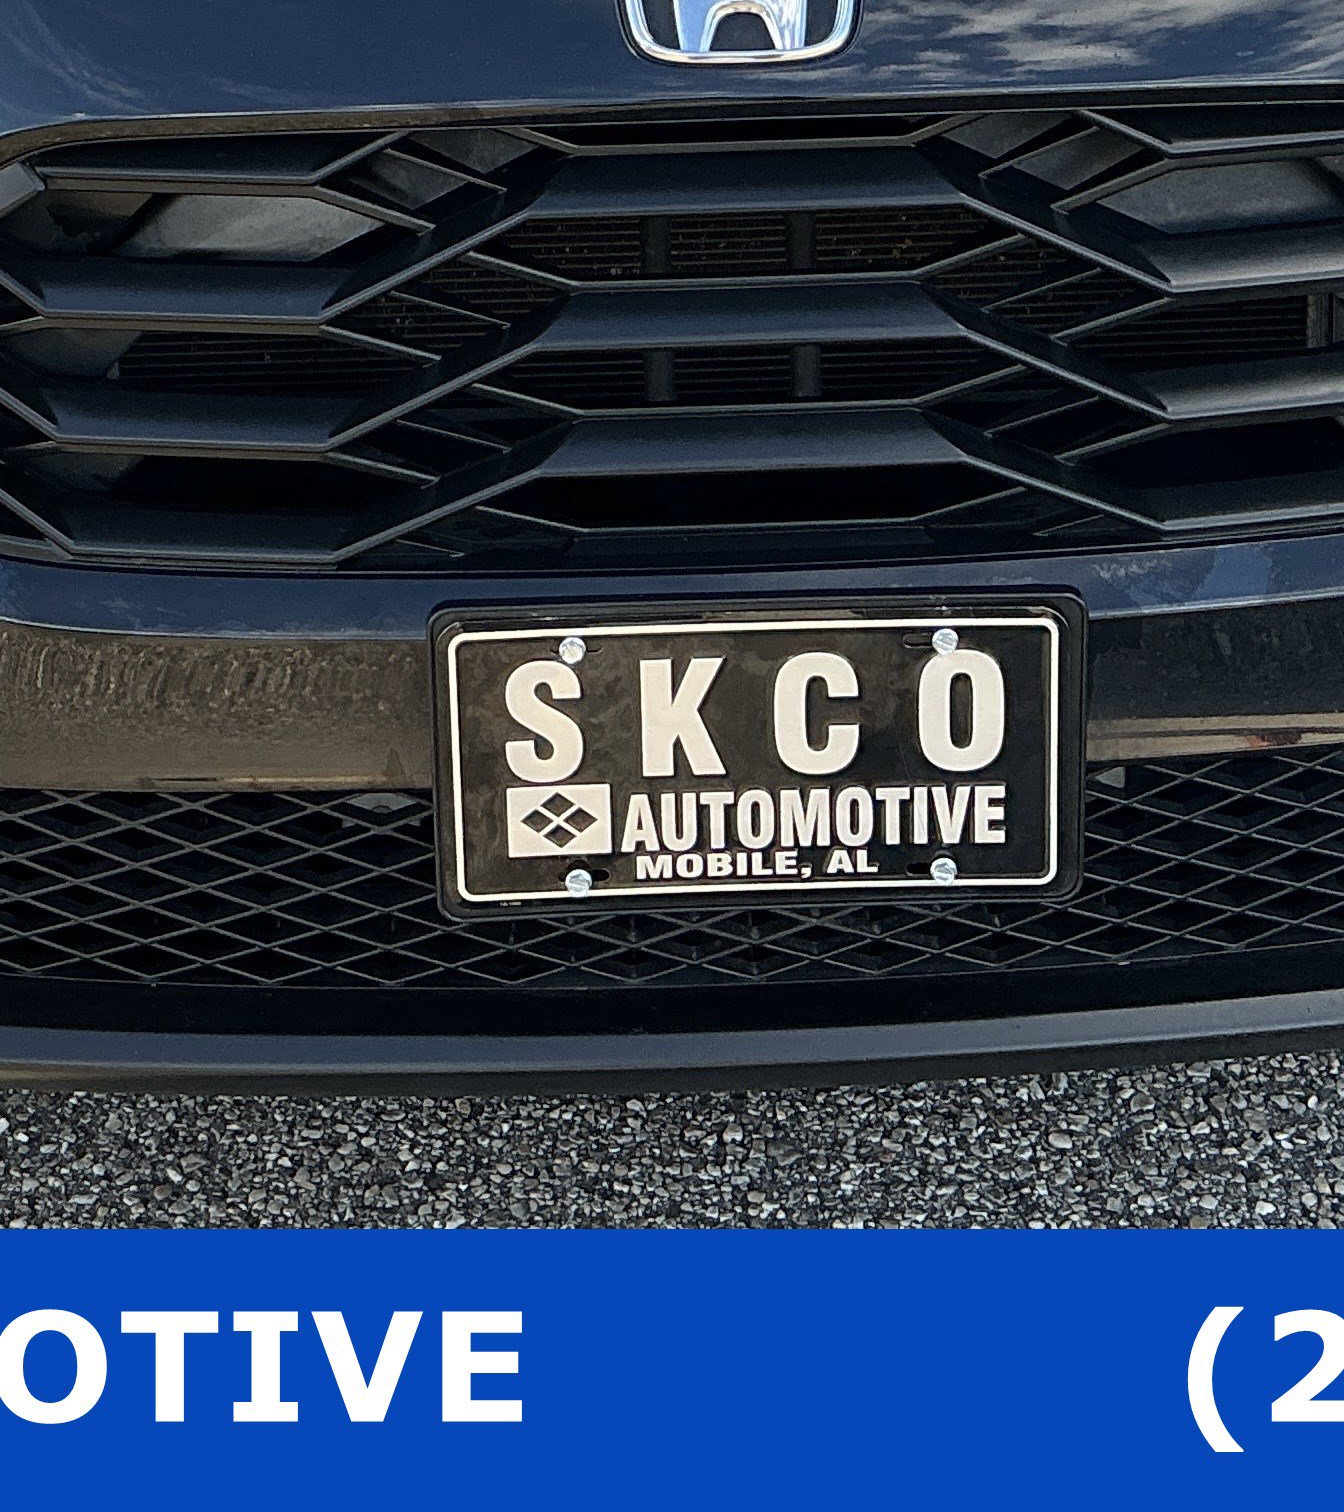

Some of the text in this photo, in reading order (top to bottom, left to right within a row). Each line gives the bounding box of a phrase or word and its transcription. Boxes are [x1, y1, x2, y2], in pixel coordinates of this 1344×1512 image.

[504, 648, 1007, 784] SKCO
[620, 785, 1007, 854] AUTOMOTIVE
[635, 849, 879, 880] MOBILE, AL
